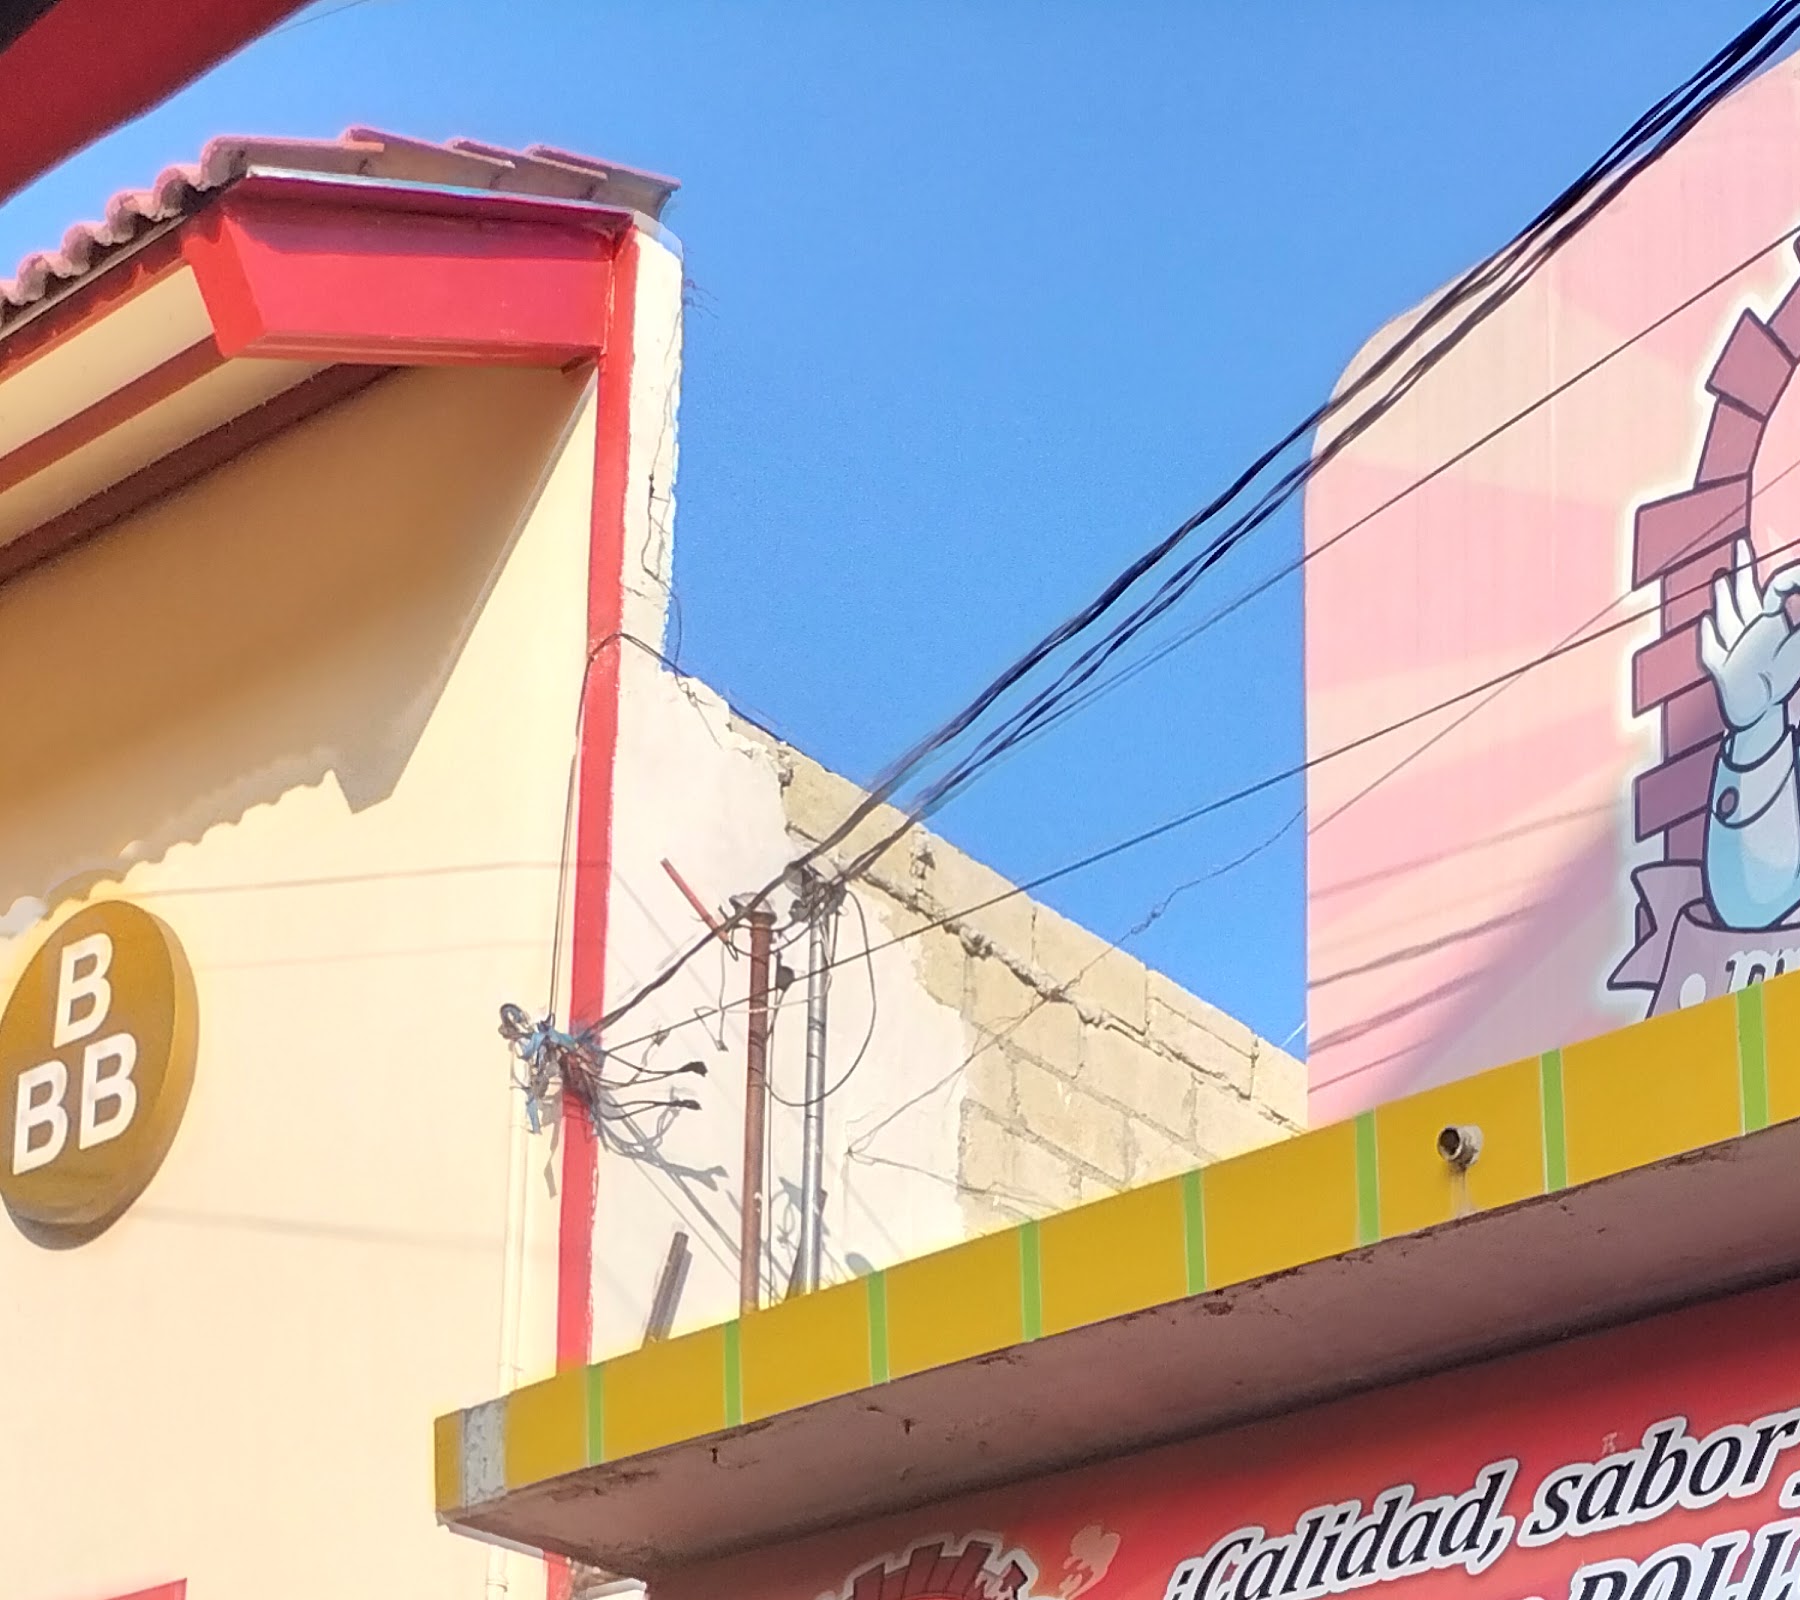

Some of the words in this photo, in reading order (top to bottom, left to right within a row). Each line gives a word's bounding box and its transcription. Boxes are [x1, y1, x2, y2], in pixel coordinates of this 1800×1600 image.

[52, 933, 114, 1048] B
[13, 1033, 138, 1175] BB
[1528, 1424, 1798, 1540] sabor
